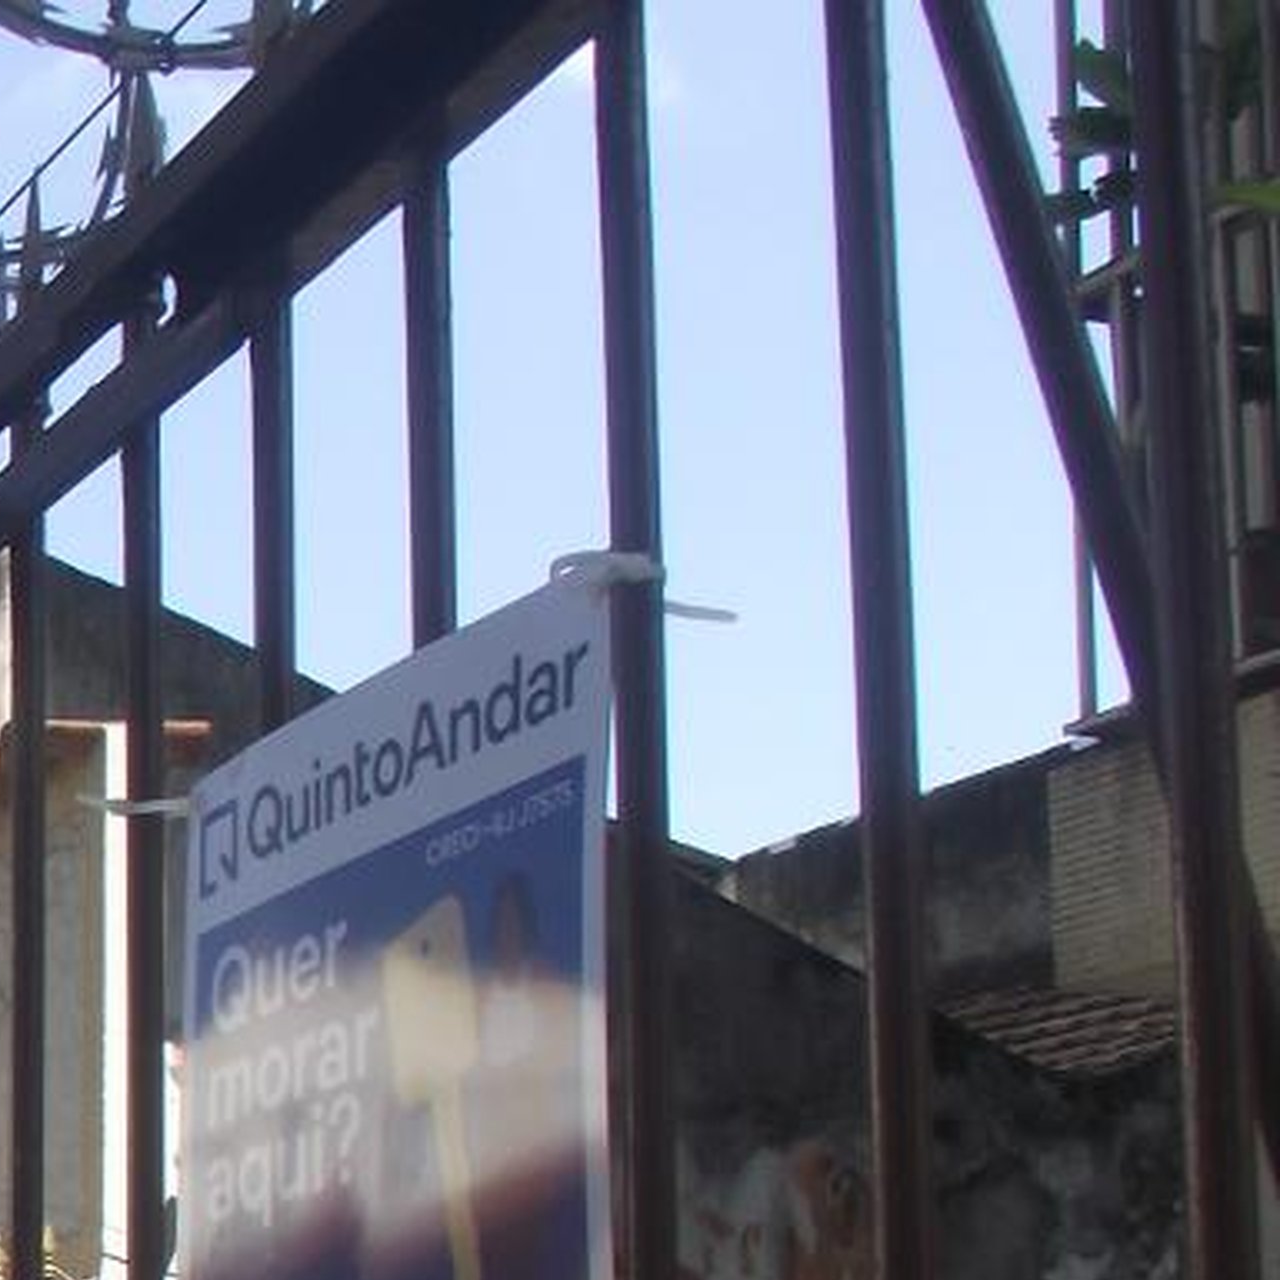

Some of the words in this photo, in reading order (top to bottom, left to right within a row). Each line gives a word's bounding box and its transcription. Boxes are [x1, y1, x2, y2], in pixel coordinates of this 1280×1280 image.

[246, 641, 589, 859] QuintoAndar
[212, 919, 348, 1033] Quer
[208, 1006, 379, 1131] morar
[207, 1093, 360, 1228] aqui?
